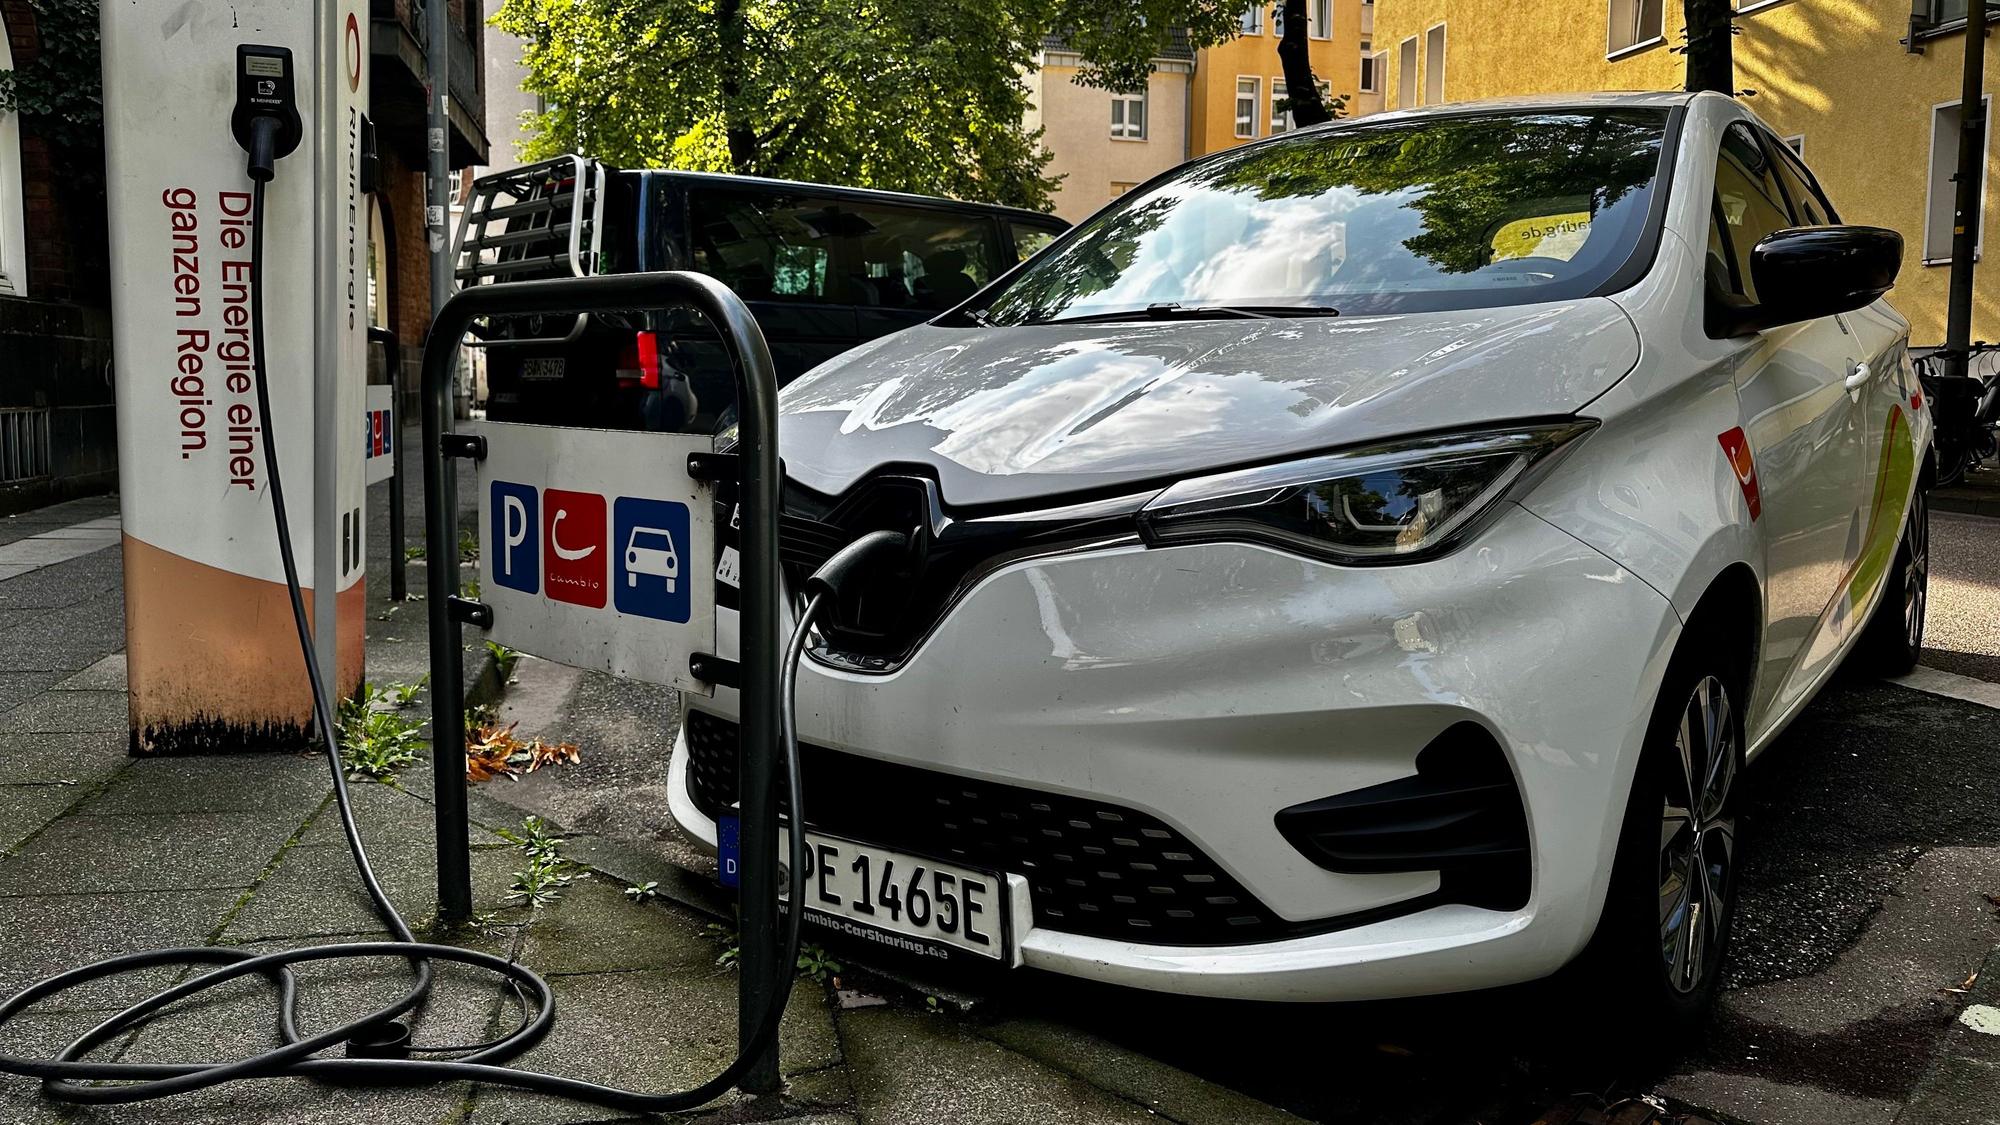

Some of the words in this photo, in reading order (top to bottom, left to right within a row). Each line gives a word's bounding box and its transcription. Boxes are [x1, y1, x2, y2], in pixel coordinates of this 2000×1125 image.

[162, 188, 201, 316] ganzen
[219, 191, 252, 249] Die
[347, 105, 356, 331] RheinEnergie
[217, 261, 256, 393] Energie
[171, 330, 212, 459] Region.
[227, 404, 260, 491] einer
[504, 495, 527, 575] P
[550, 573, 599, 588] cambio
[726, 858, 737, 874] D
[852, 854, 990, 946] 1465E
